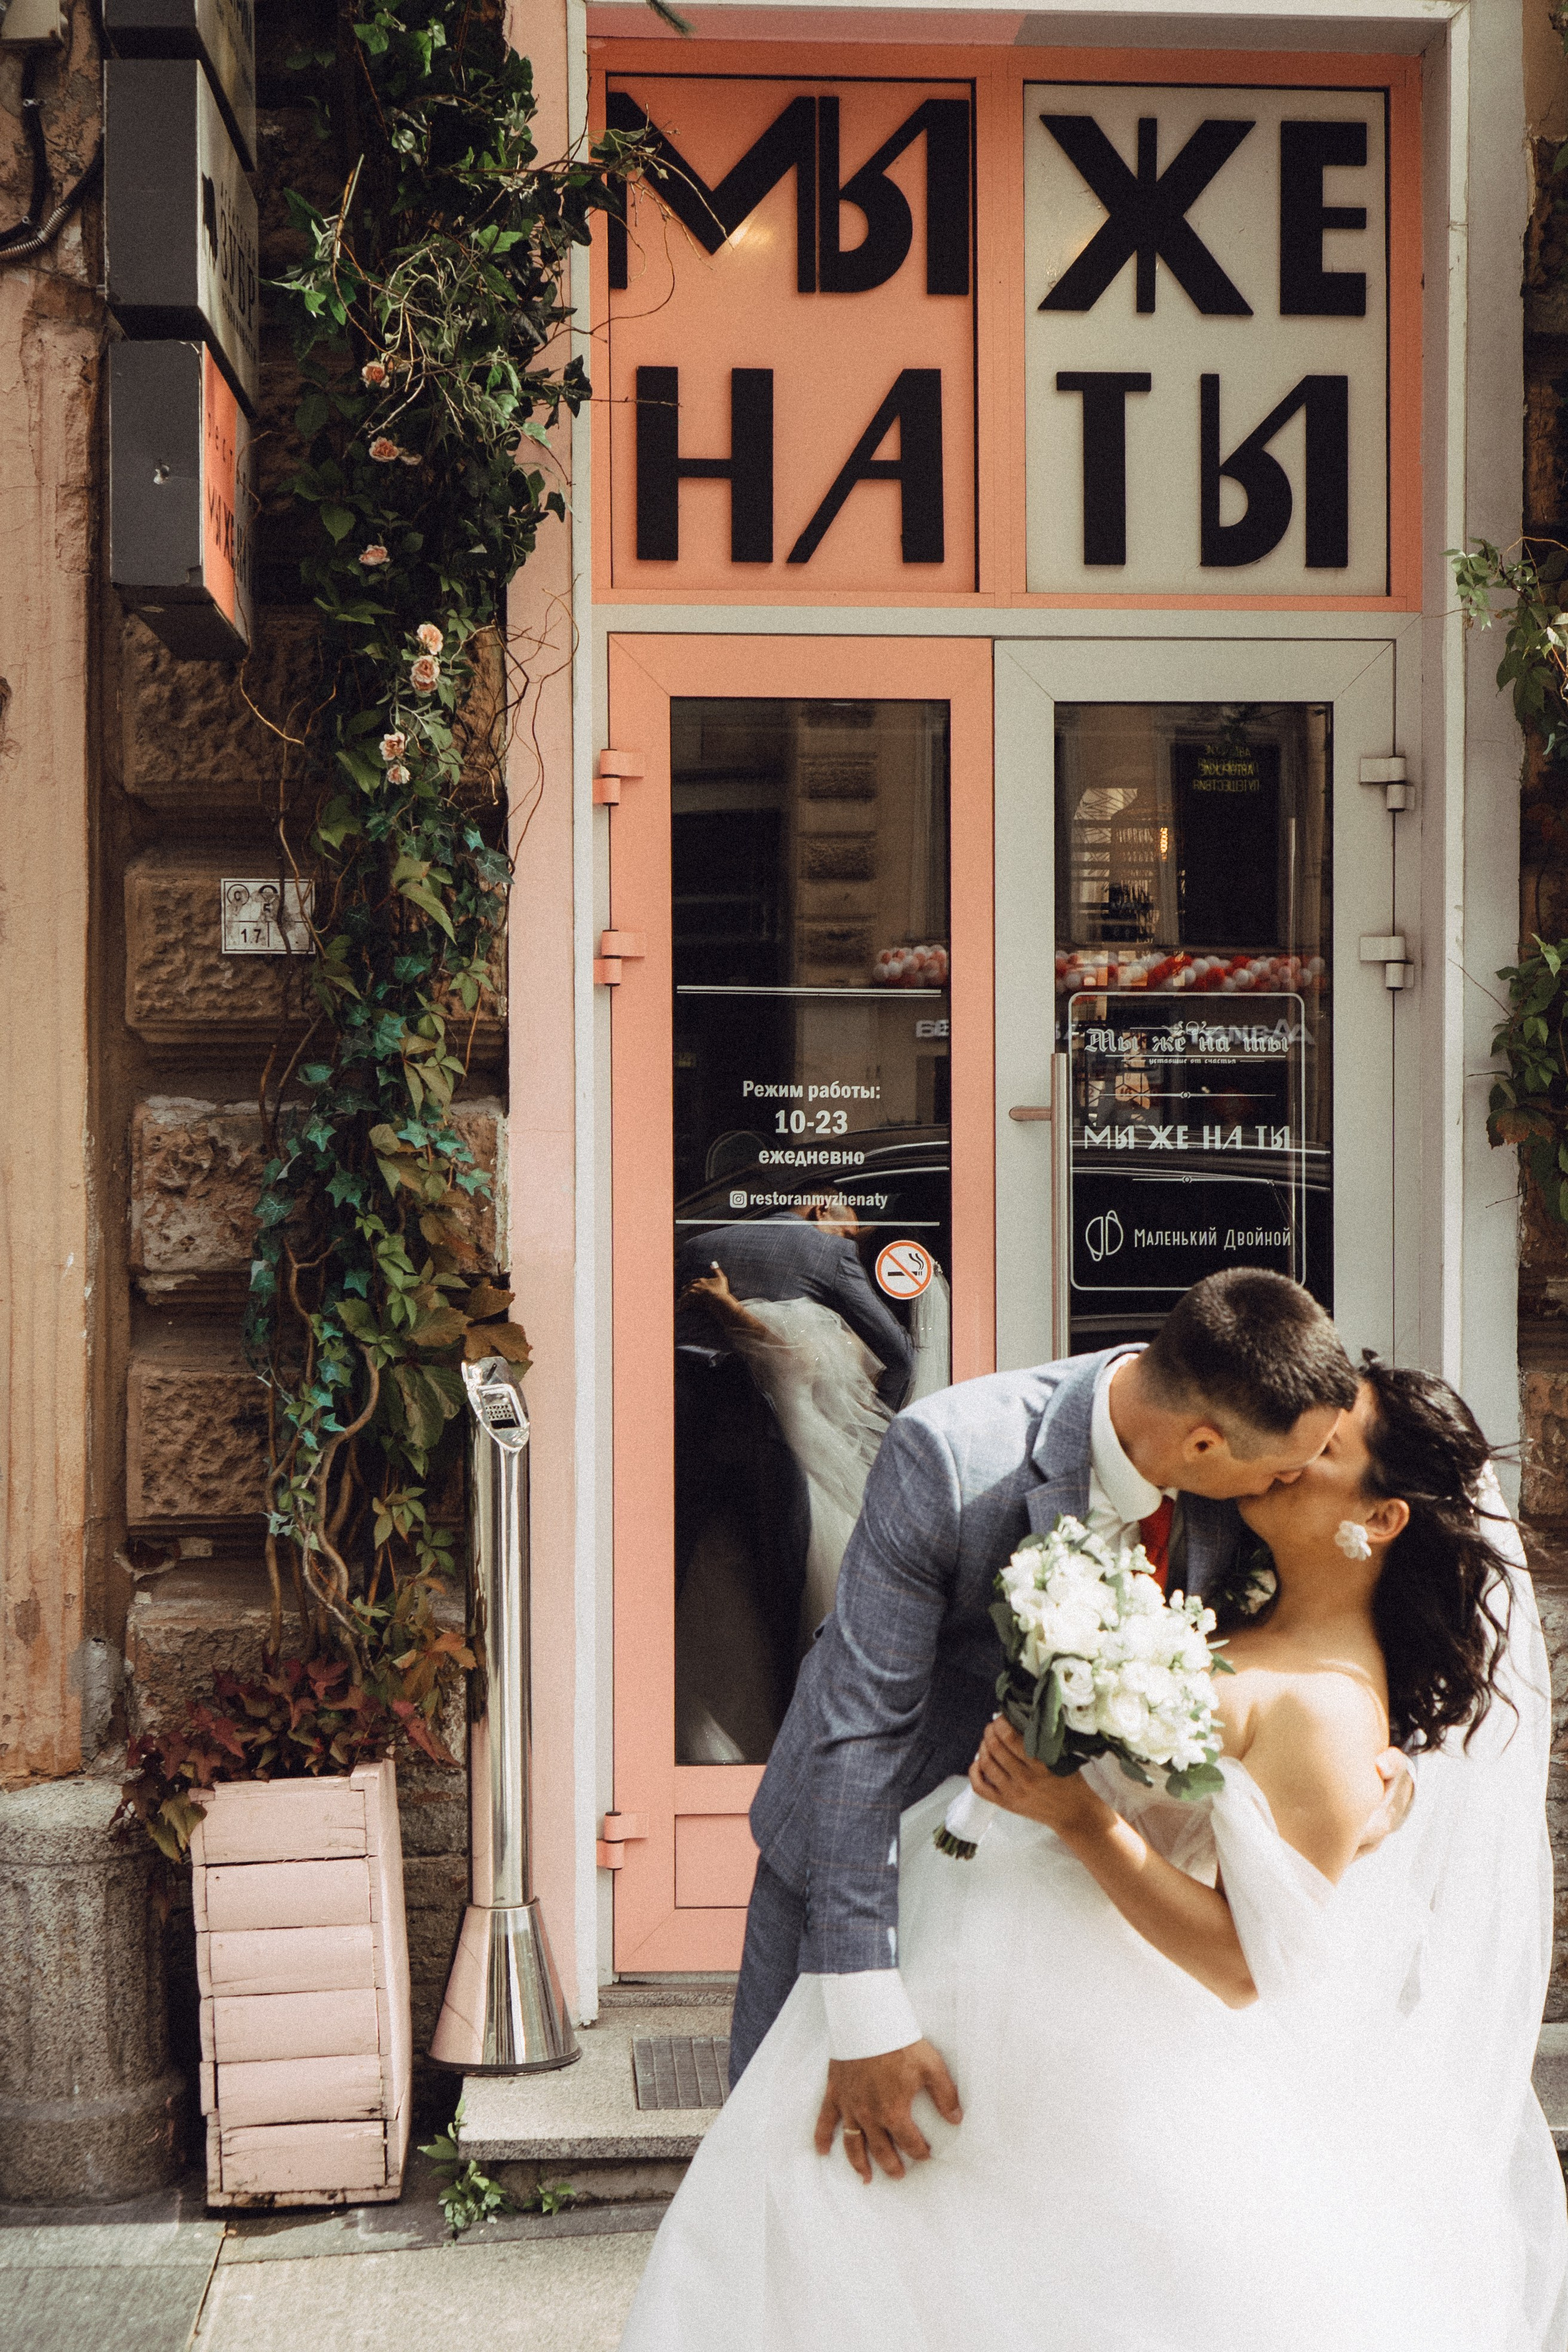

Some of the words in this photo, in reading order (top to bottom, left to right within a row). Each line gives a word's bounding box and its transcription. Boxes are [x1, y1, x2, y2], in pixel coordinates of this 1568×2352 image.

[606, 92, 970, 295] МЫ
[1038, 114, 1368, 317] ЖЕ
[220, 208, 256, 331] ЗУБР
[636, 366, 945, 565] НА
[1056, 371, 1349, 568] ТЫ
[241, 929, 262, 943] 17
[1085, 1028, 1139, 1053] Мы
[743, 1080, 804, 1098] Режим
[808, 1080, 881, 1101] работы:
[775, 1110, 848, 1134] 10-23
[1148, 1126, 1189, 1150] ЖЕ
[1203, 1126, 1243, 1150] НА
[758, 1150, 865, 1167] ежедневно
[750, 1191, 888, 1209] restoranmyzhenaty
[1134, 1226, 1217, 1248] Маленький
[1224, 1227, 1291, 1250] Двойной
